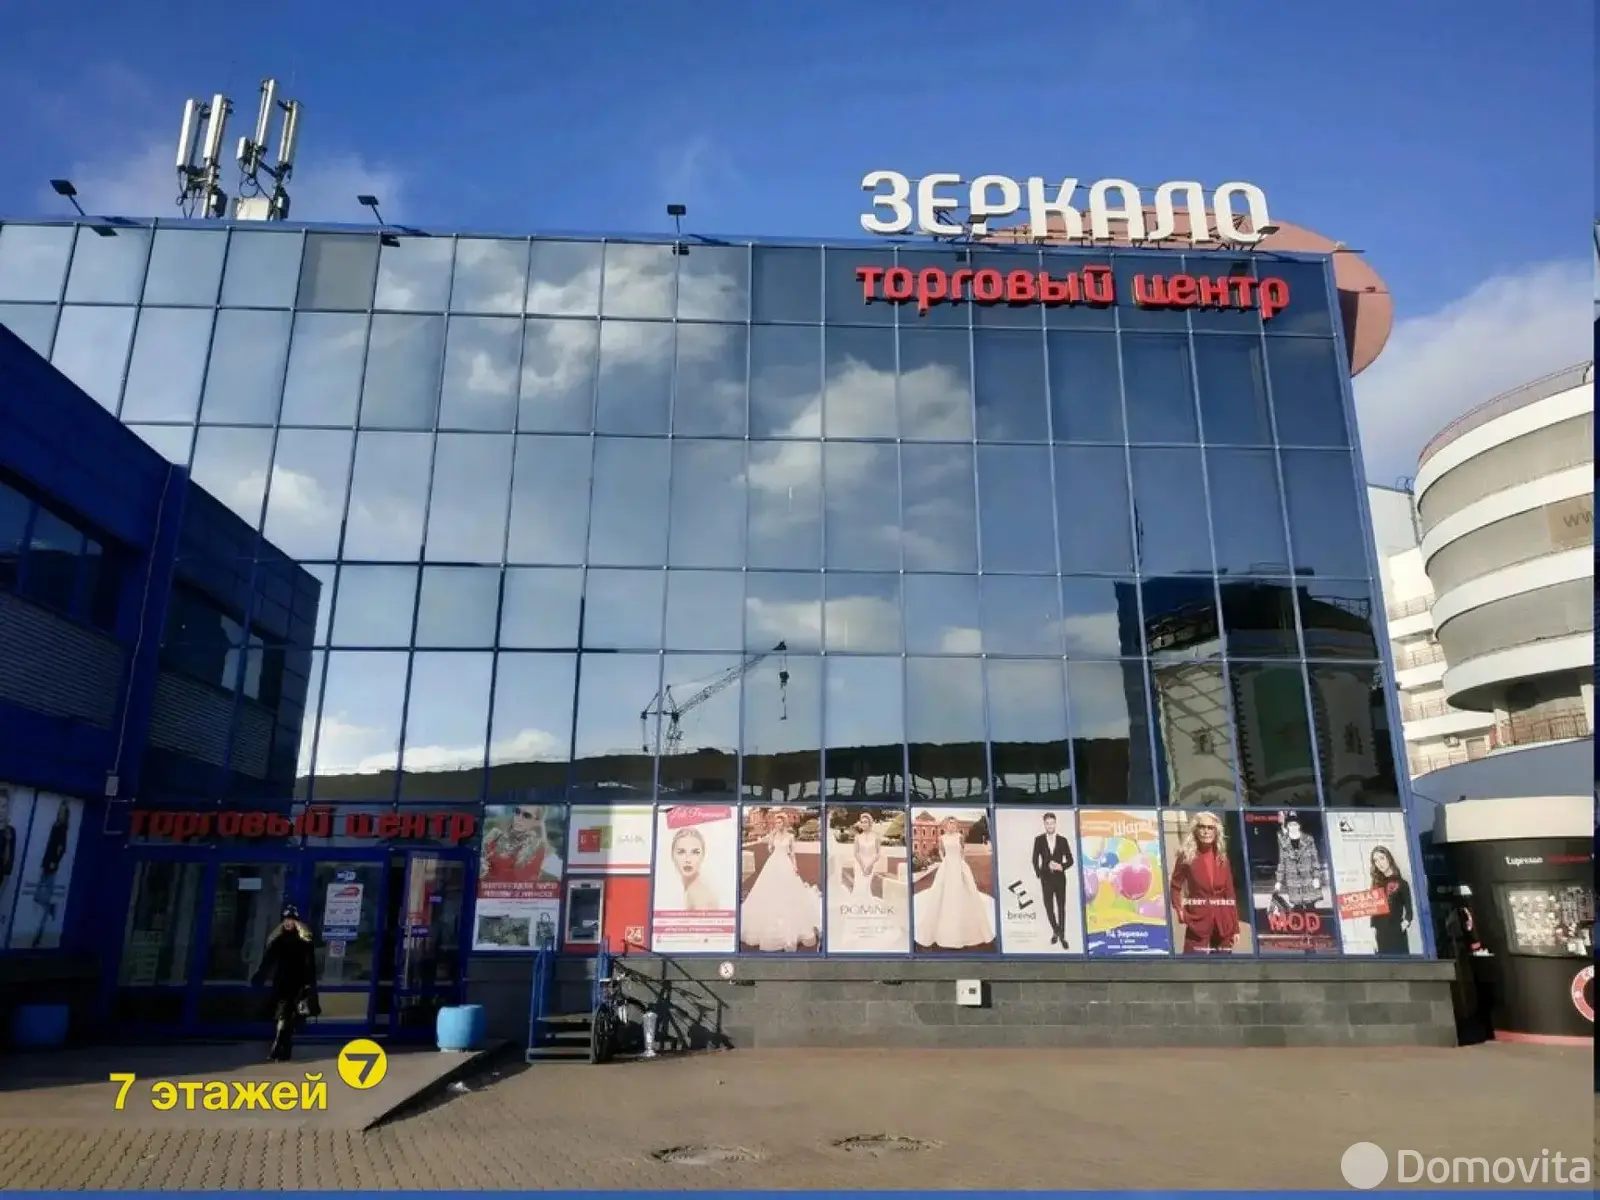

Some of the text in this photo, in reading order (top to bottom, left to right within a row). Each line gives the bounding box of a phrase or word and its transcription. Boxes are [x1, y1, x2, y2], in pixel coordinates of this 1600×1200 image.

[860, 170, 1270, 244] ЗЕРКАЛО
[855, 264, 1290, 320] торговый центр
[129, 806, 475, 843] торговый центр
